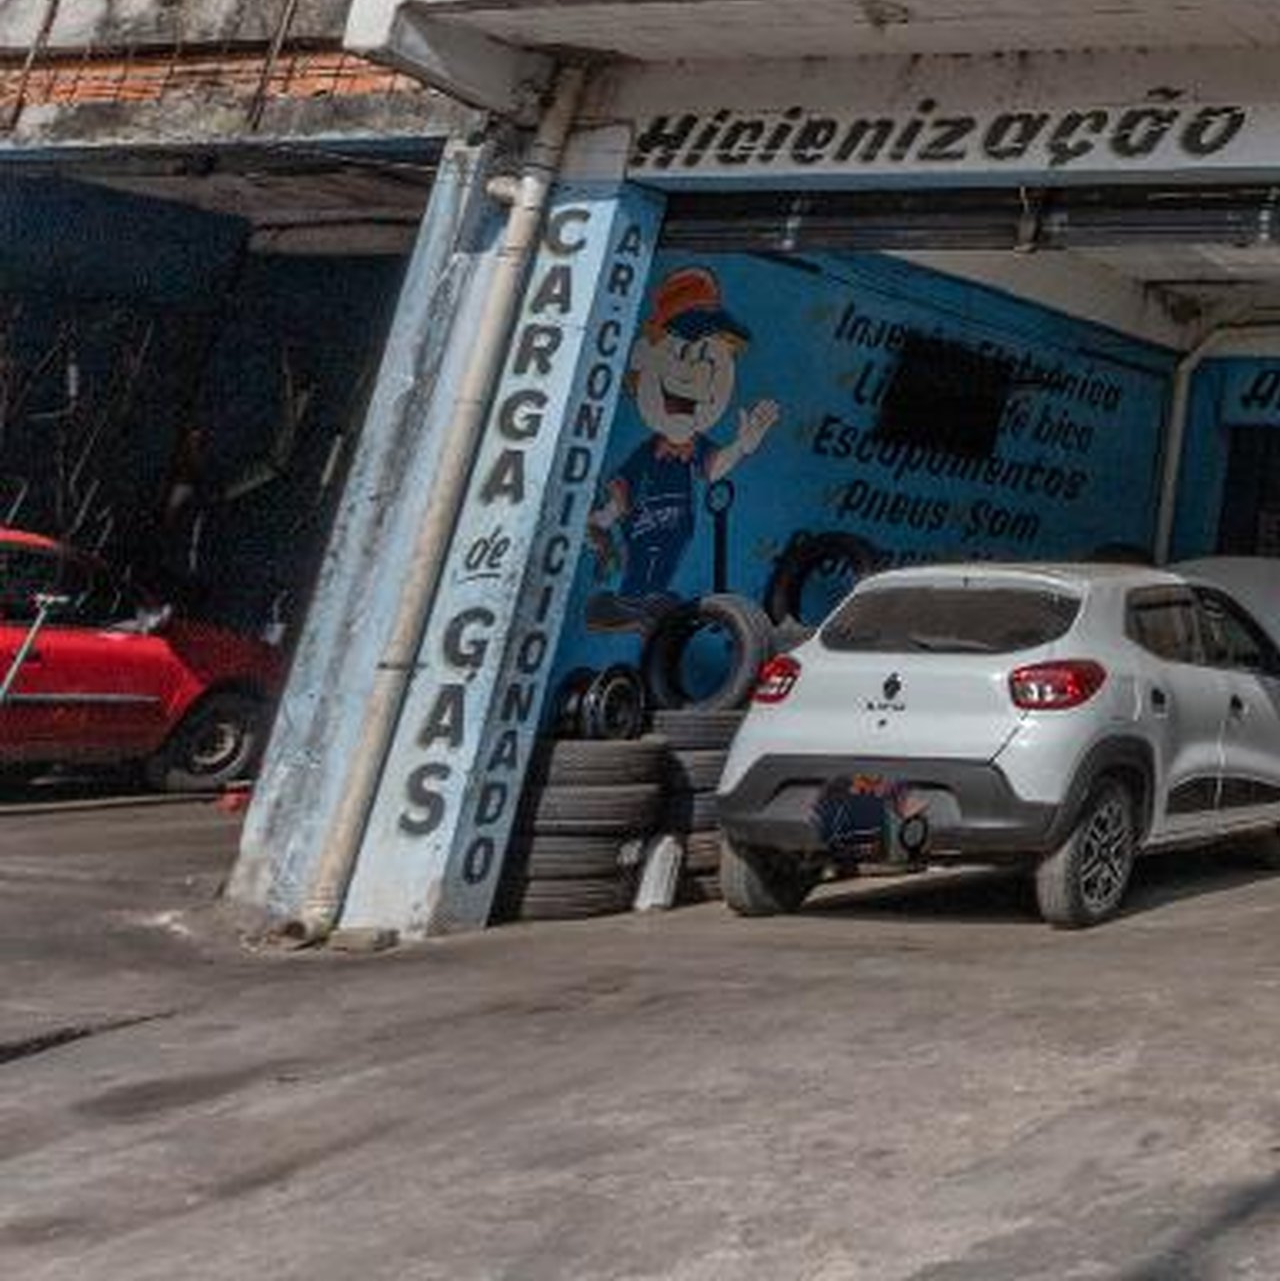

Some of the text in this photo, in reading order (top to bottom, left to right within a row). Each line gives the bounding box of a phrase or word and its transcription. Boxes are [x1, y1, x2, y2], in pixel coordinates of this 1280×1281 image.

[631, 85, 1246, 169] Higienização
[479, 207, 591, 507] CARGA
[464, 525, 509, 571] de
